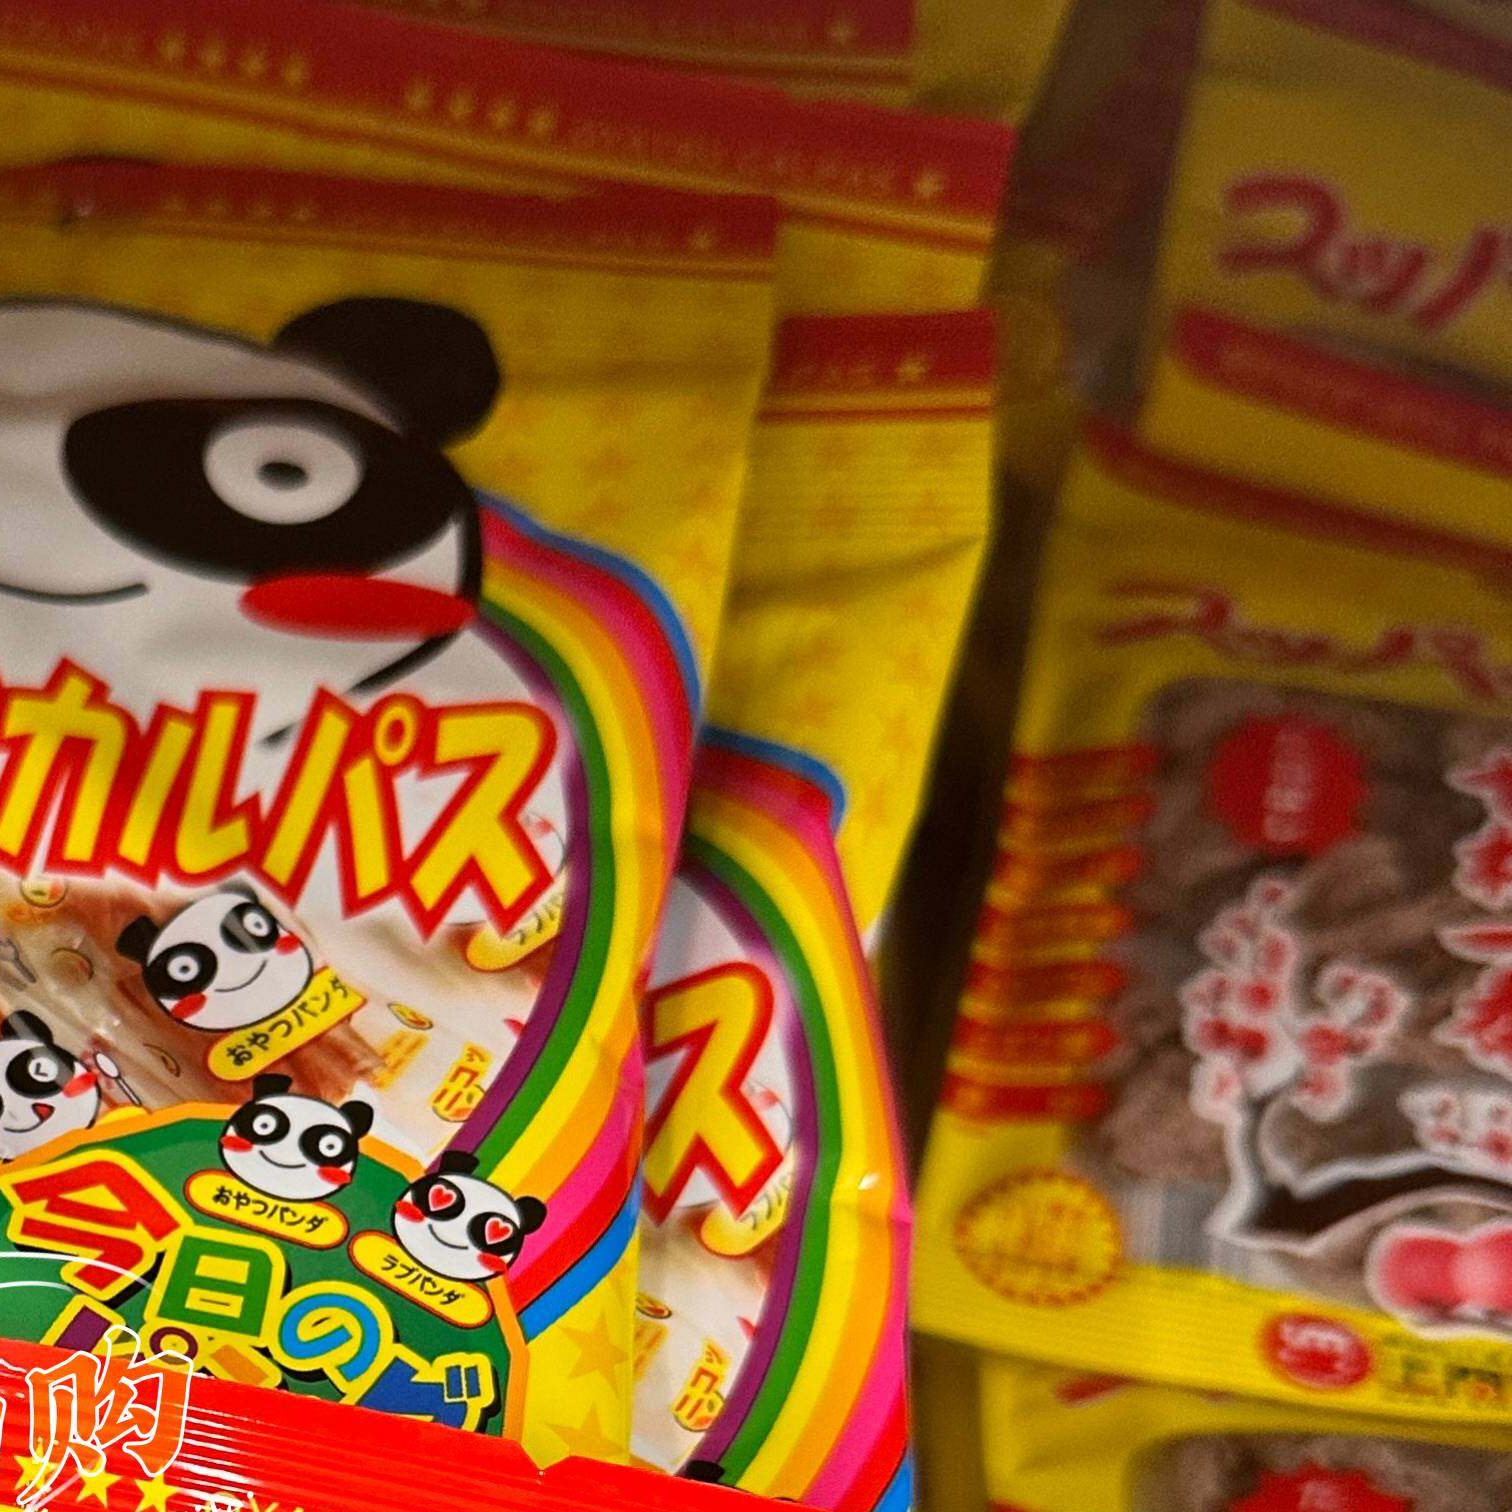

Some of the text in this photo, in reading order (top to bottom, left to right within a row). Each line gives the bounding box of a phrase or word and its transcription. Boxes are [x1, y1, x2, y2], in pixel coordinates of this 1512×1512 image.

[226, 972, 352, 1068] おやつパンダ
[211, 1184, 330, 1234] おやつパンダ
[381, 1252, 466, 1308] ラブパンダ
